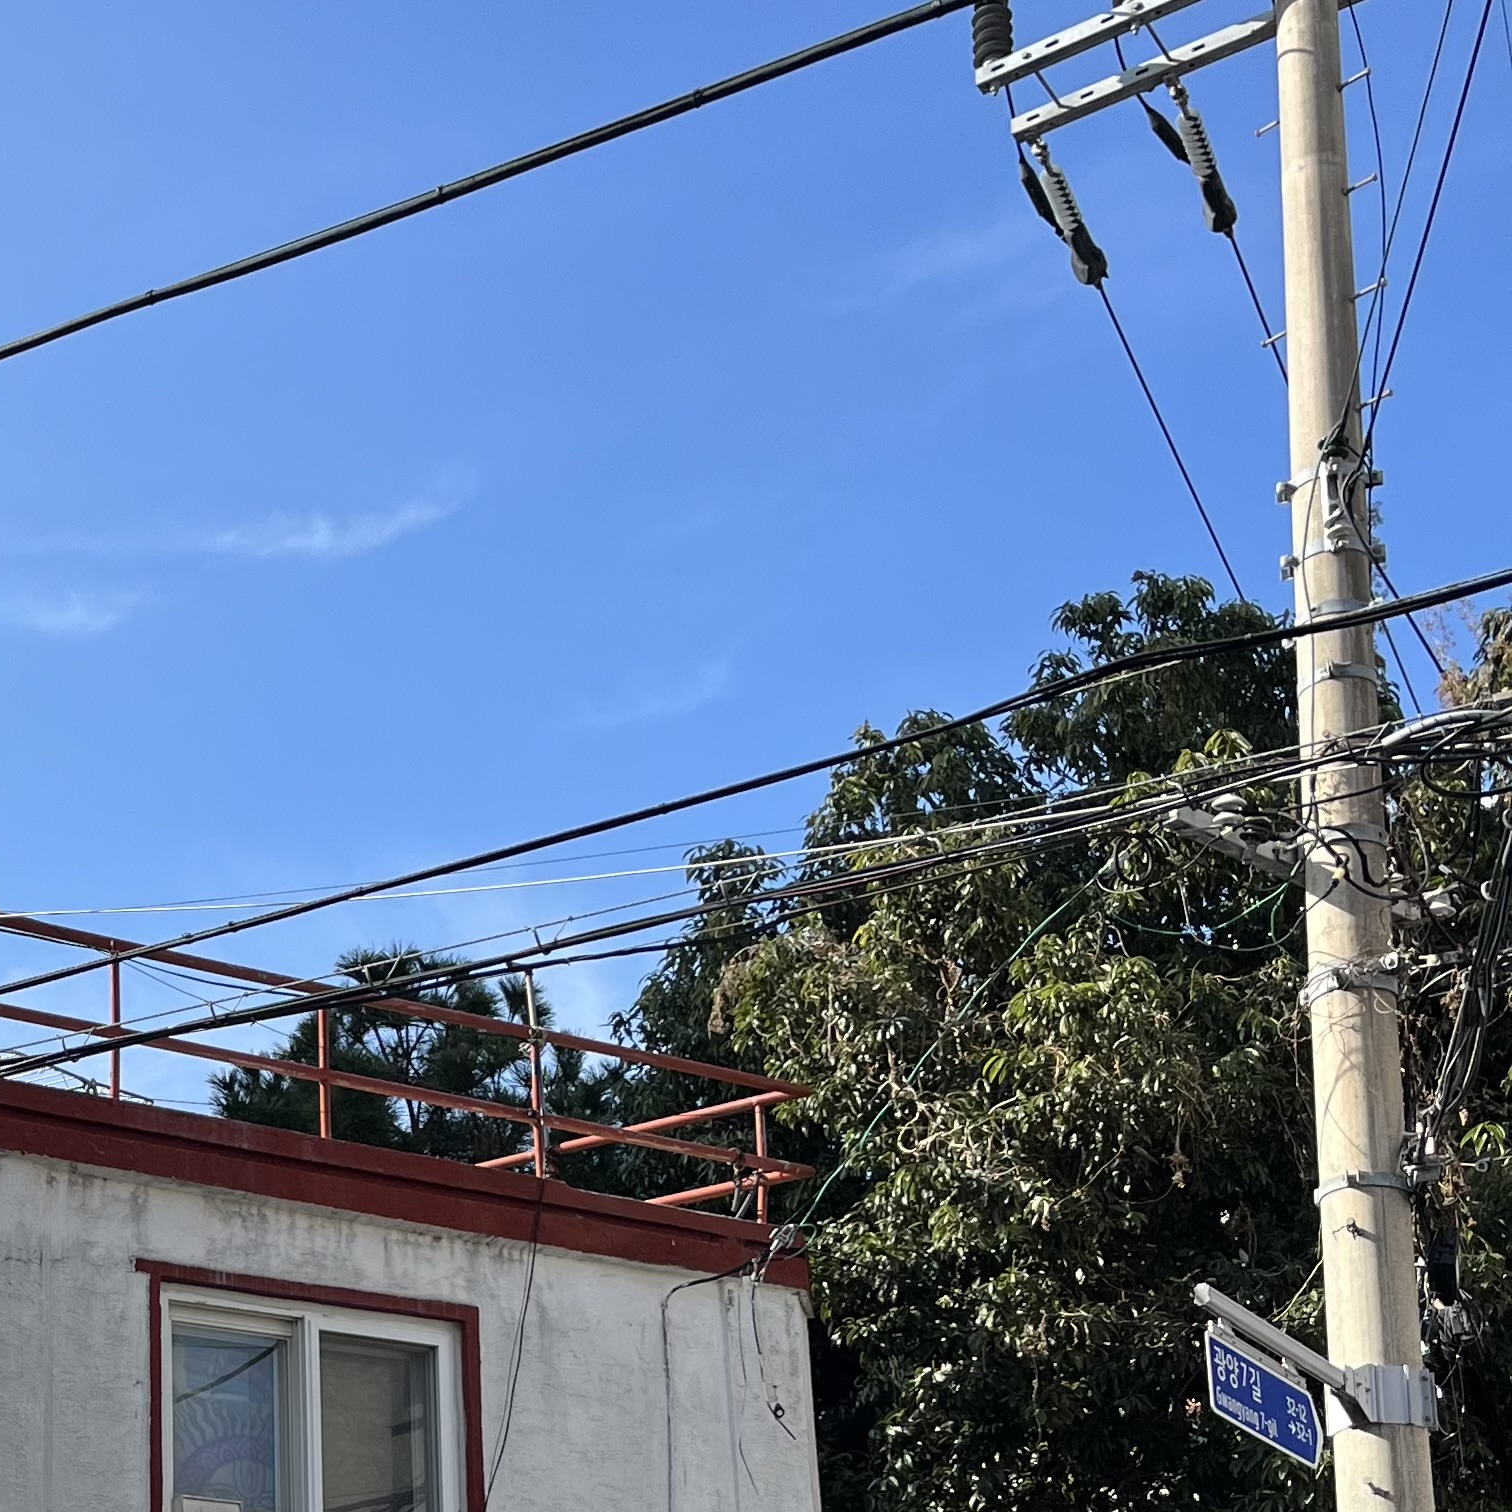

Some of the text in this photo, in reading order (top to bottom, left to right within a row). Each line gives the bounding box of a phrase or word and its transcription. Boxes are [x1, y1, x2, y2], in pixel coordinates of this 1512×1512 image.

[1213, 1345, 1262, 1404] 광양7길
[1216, 1386, 1279, 1439] Gwangyang 7-gil
